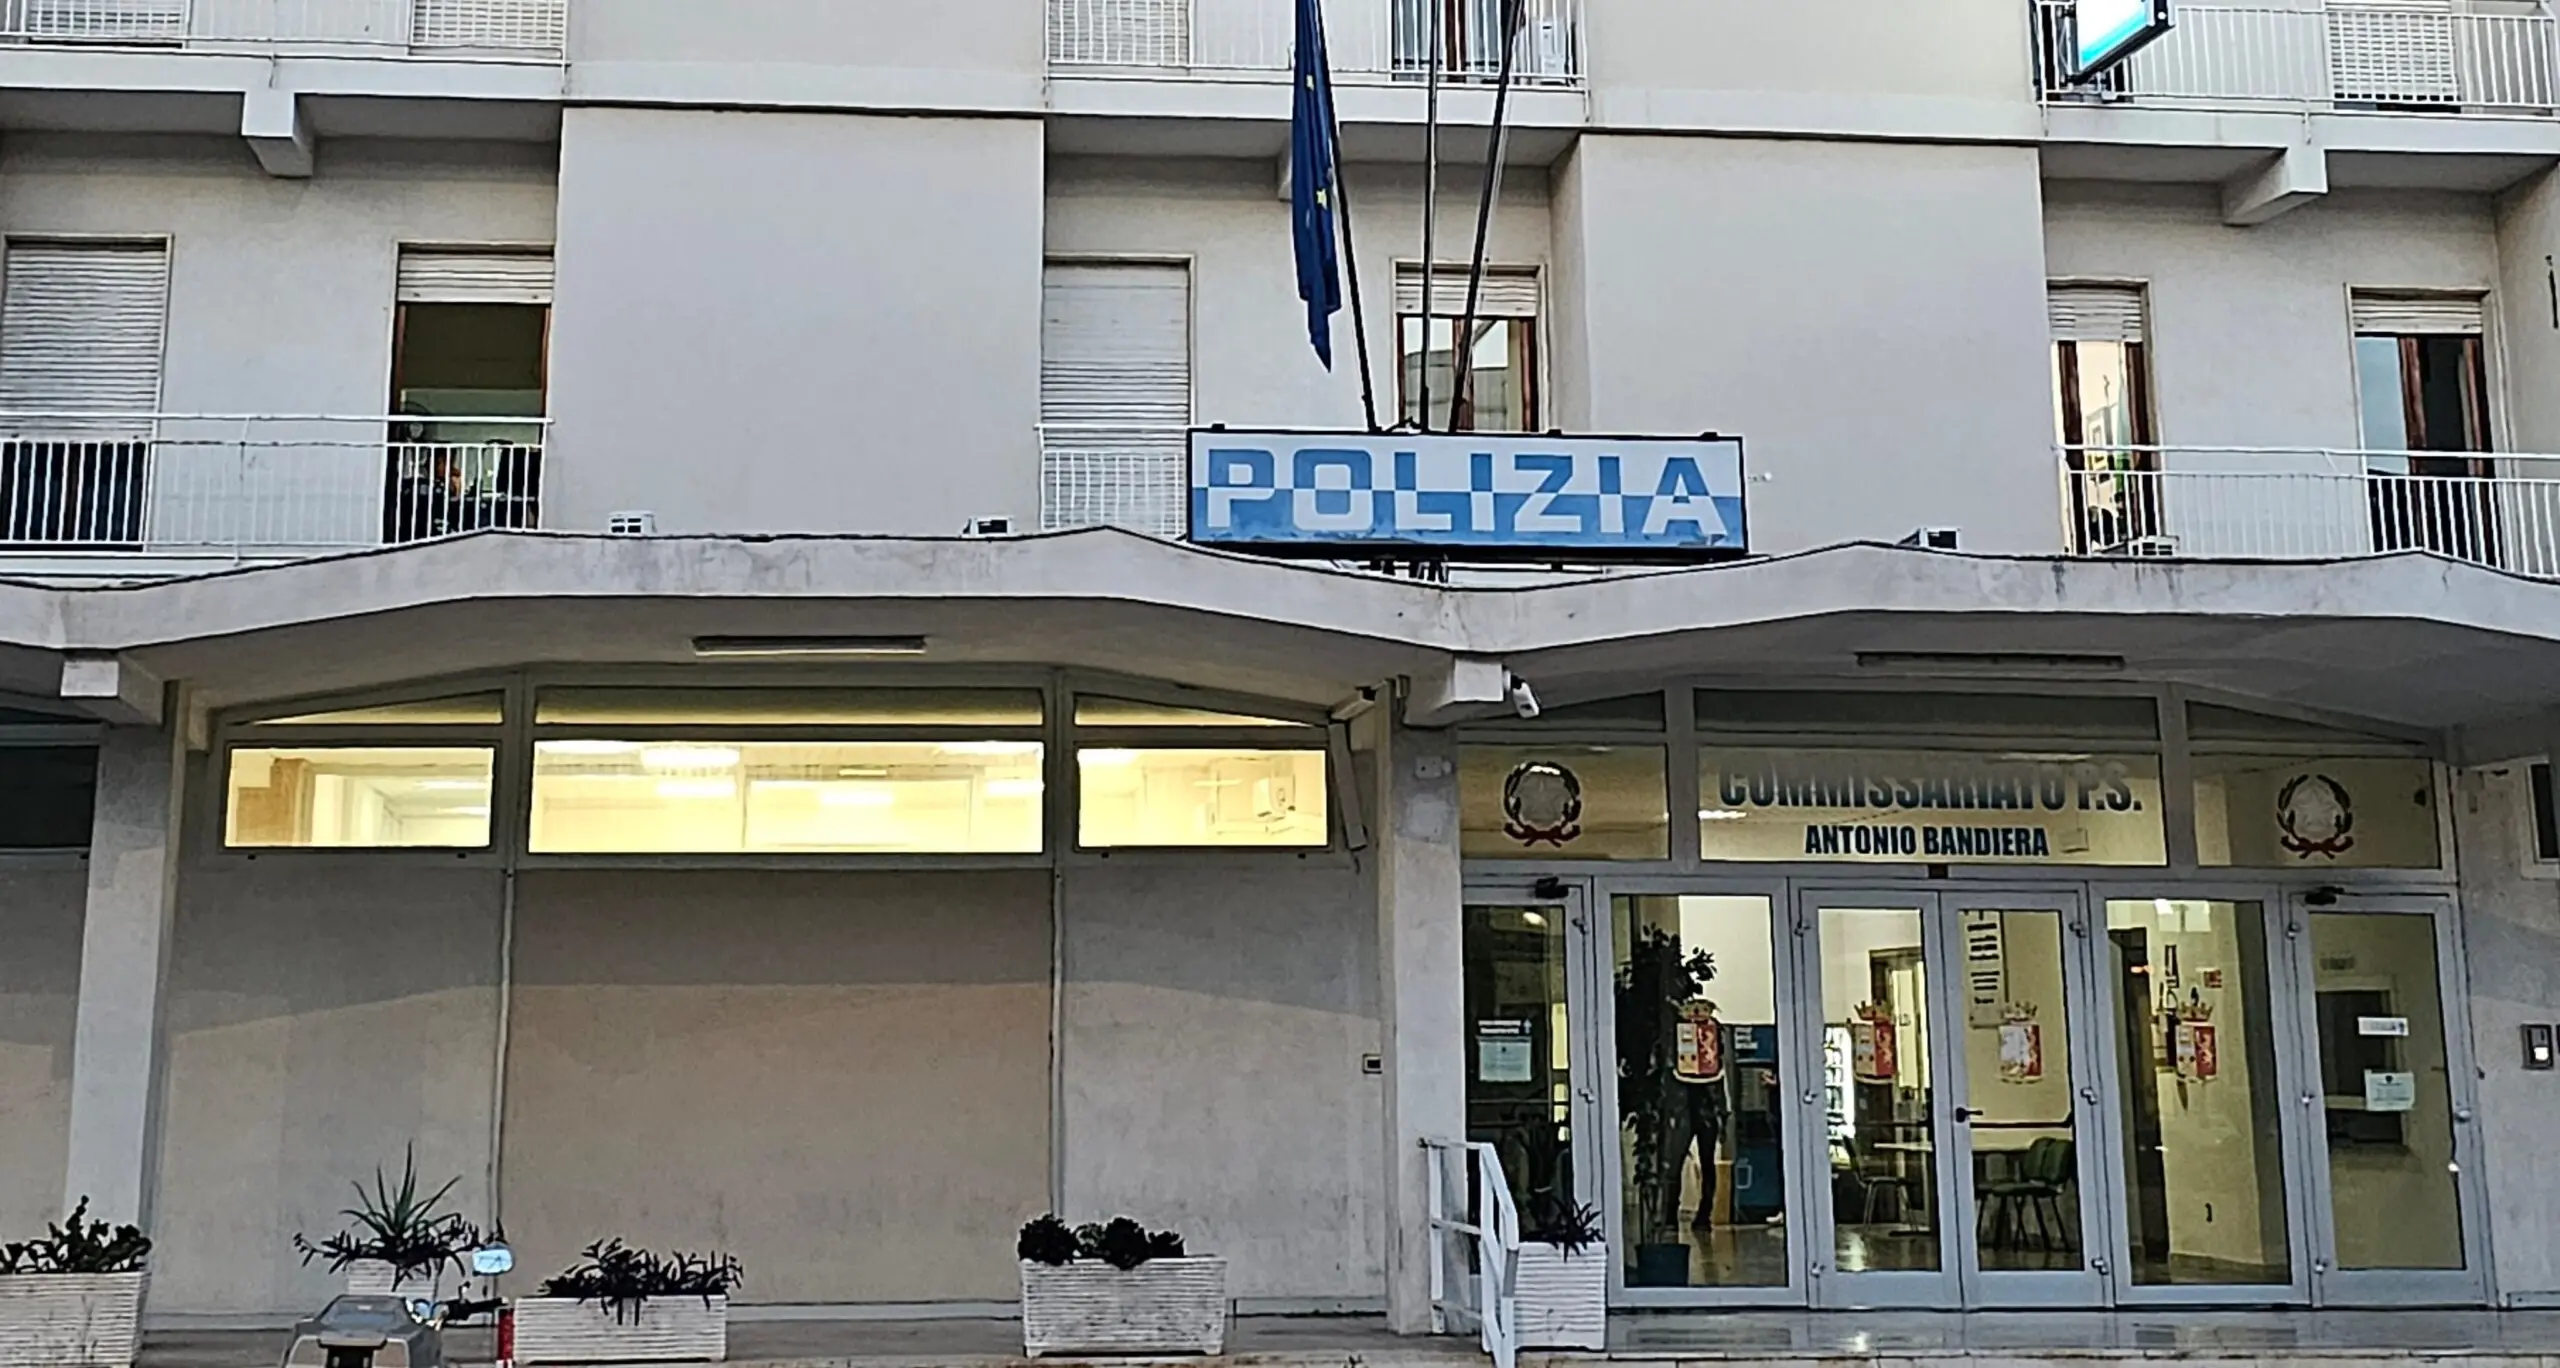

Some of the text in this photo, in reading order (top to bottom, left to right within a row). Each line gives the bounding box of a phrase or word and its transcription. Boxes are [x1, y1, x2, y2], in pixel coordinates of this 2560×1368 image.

[1207, 448, 1728, 536] POLIZIA
[1718, 763, 2142, 812] COMMISSARIATO P.S.
[1805, 825, 2049, 856] ANTONIO BANDIERA
